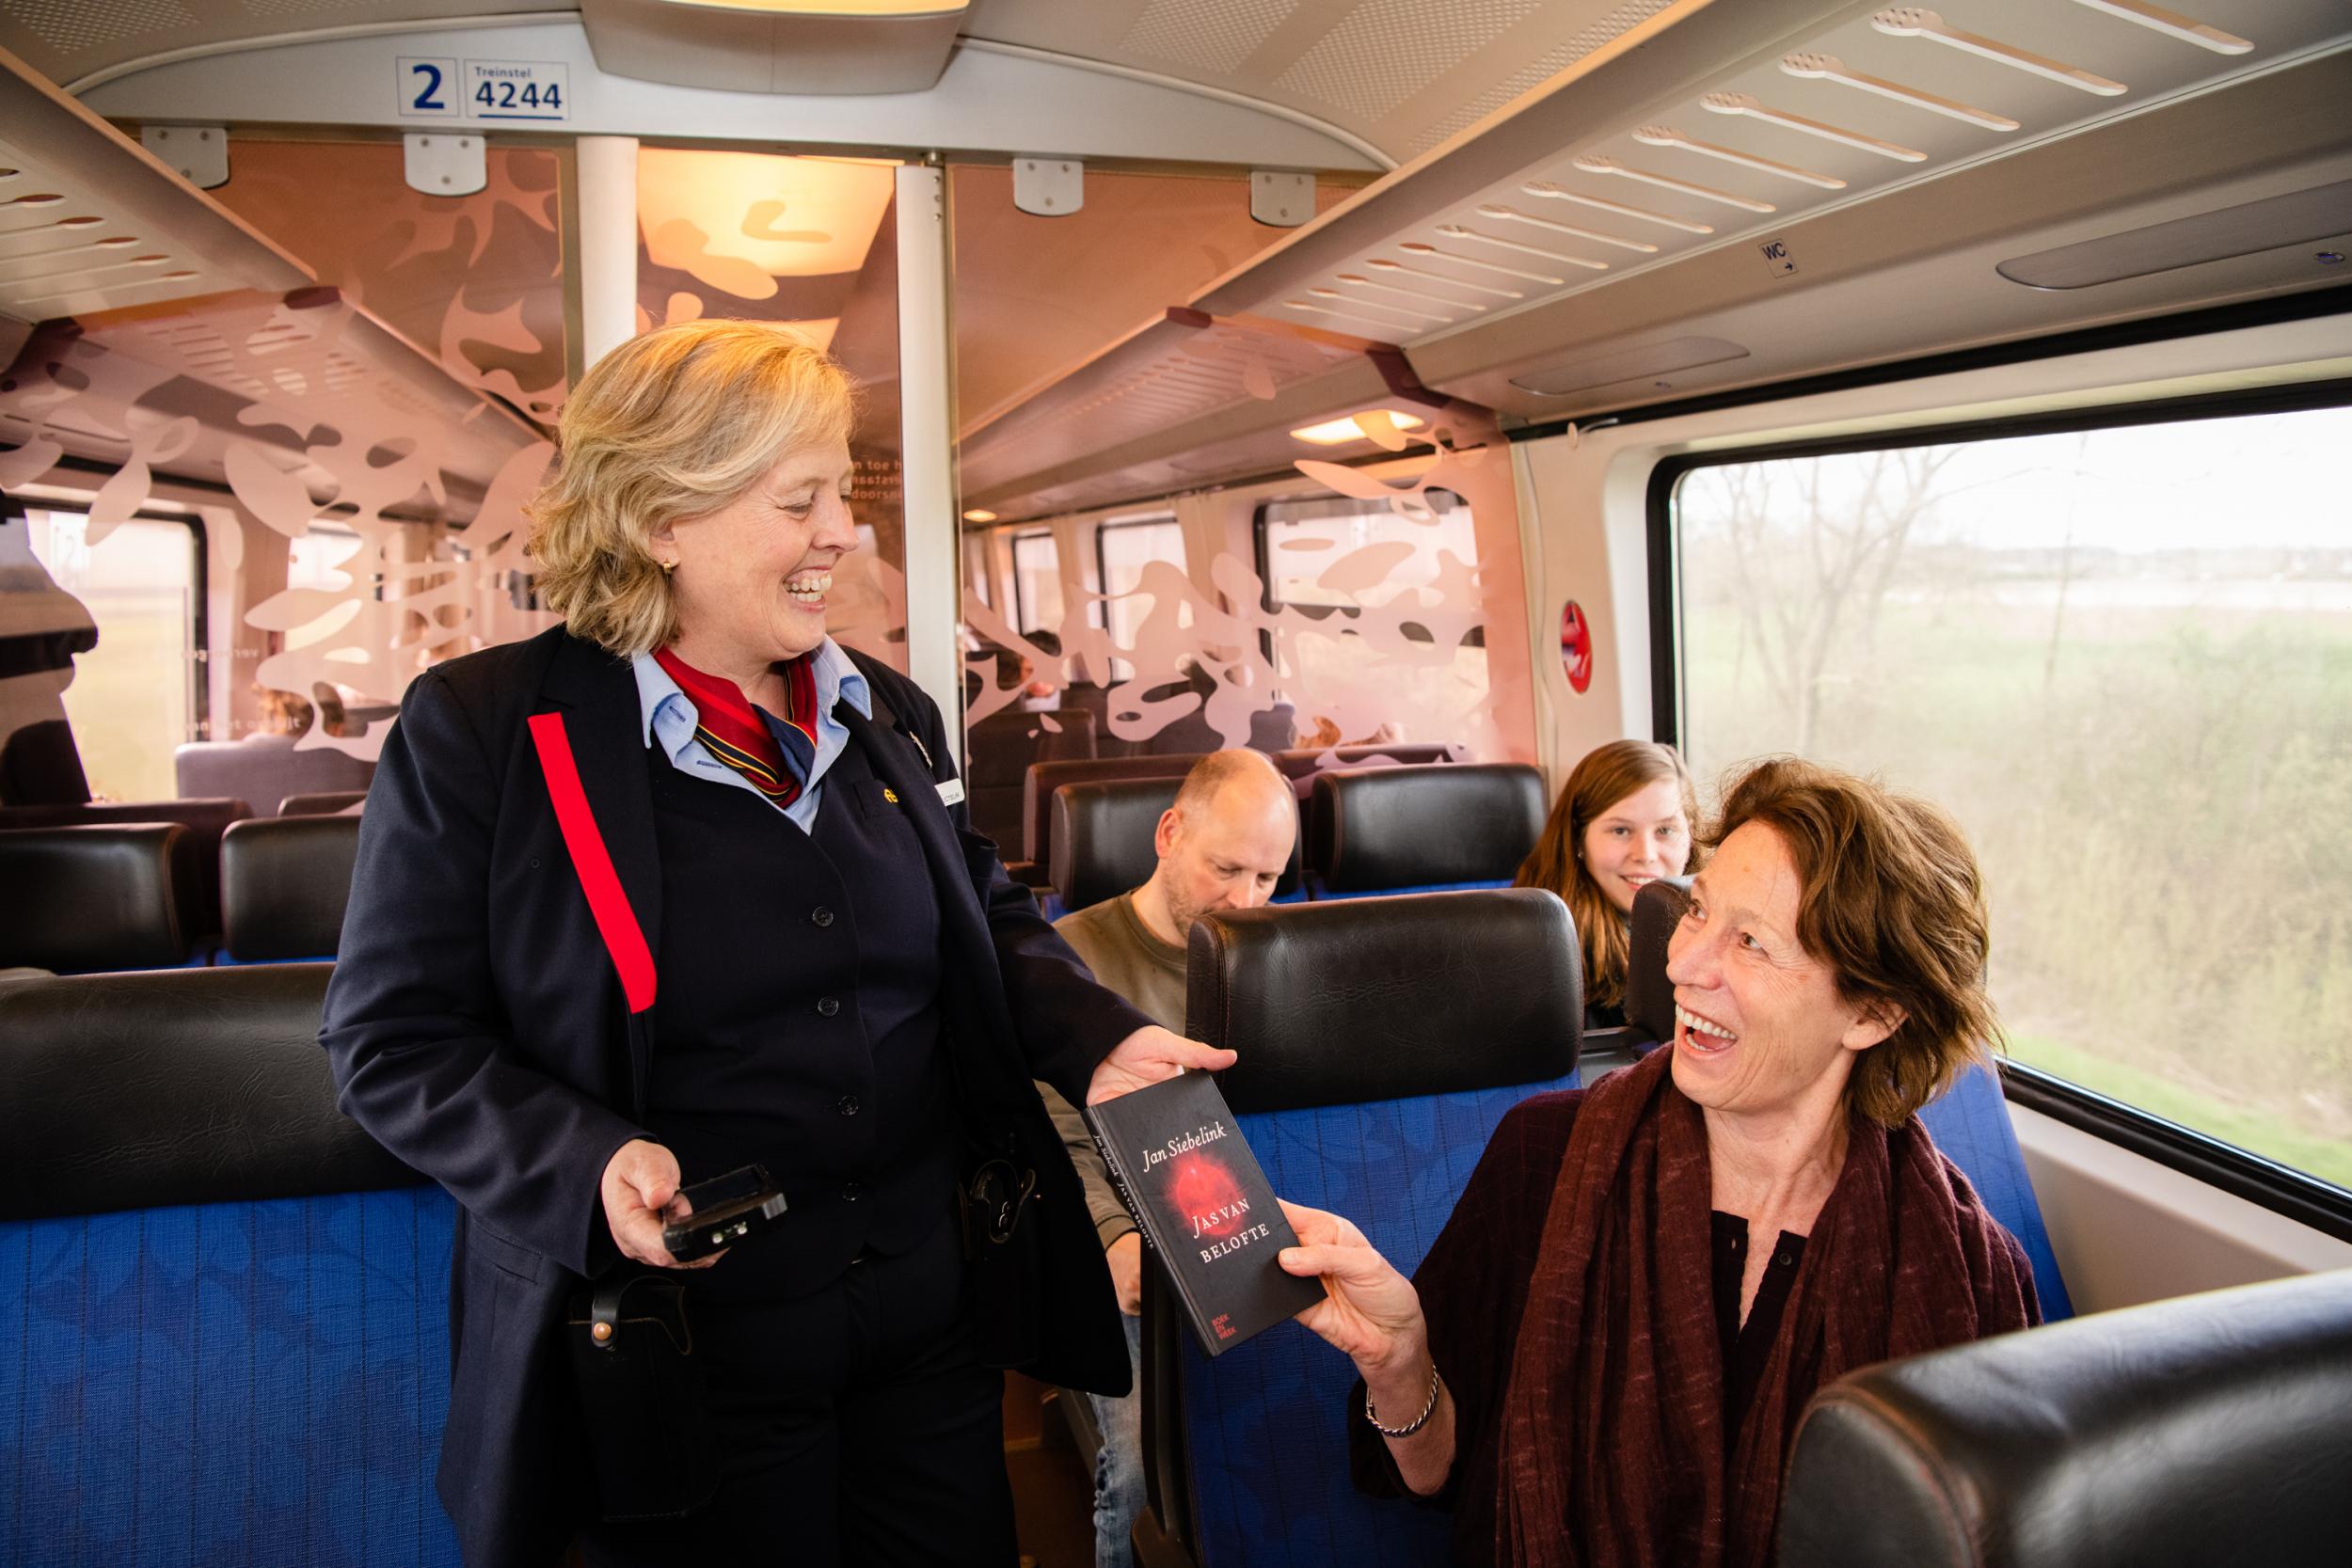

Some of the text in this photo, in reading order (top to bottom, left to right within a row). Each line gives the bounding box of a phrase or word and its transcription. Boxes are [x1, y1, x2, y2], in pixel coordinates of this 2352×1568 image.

[412, 63, 445, 109] 2
[474, 67, 532, 78] Treinstel
[475, 81, 562, 109] 4244
[1761, 242, 1787, 261] WC
[1093, 1134, 1120, 1177] Jan Siebelink
[1143, 1121, 1227, 1173] Jan Siebelink
[1127, 1196, 1136, 1213] VAN
[1135, 1214, 1154, 1250] BELOFTE
[1193, 1197, 1250, 1239] JAS VAN
[1200, 1224, 1269, 1263] BELOFTE
